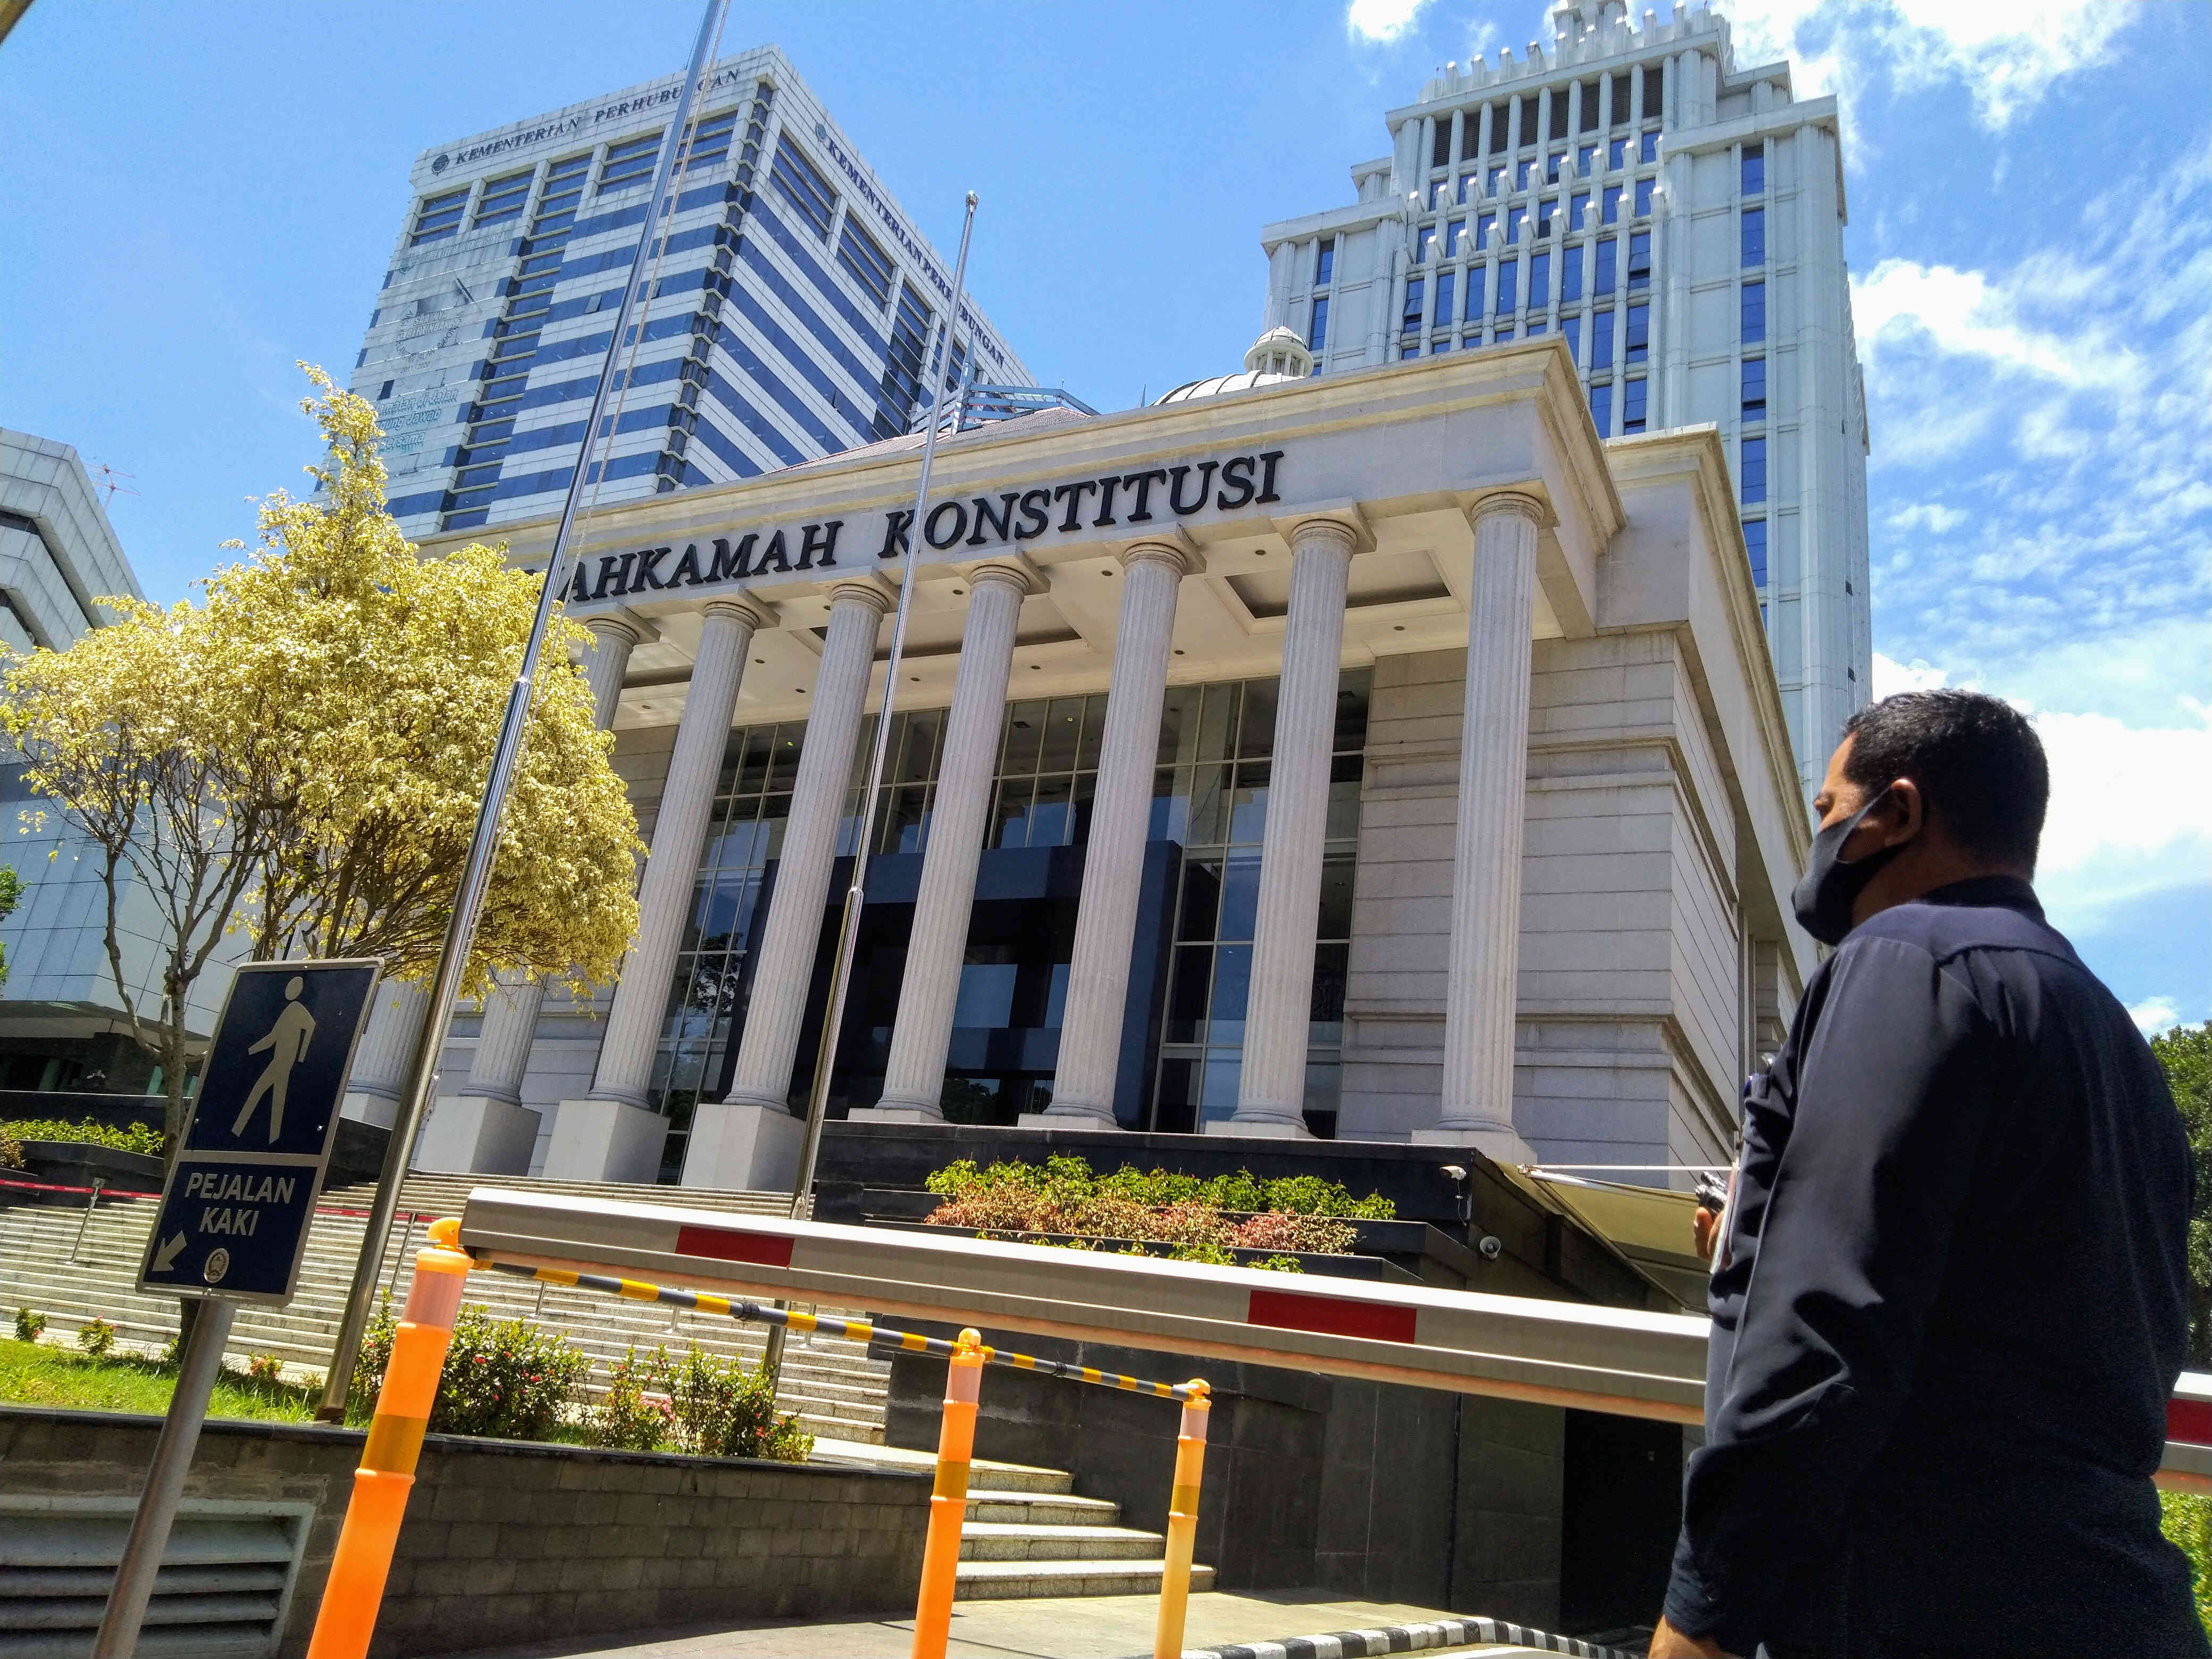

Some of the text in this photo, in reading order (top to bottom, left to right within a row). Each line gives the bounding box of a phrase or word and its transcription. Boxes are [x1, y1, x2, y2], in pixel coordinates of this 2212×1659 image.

[455, 68, 740, 166] KEMENTERIAN PERHUBUGAN
[828, 139, 1004, 369] KEMENTERIAN PERHBUNGAN
[523, 450, 1284, 602] AHKAMAH KONSTITUSI
[185, 1172, 296, 1204] PEJALAN
[198, 1207, 259, 1236] KAKI
